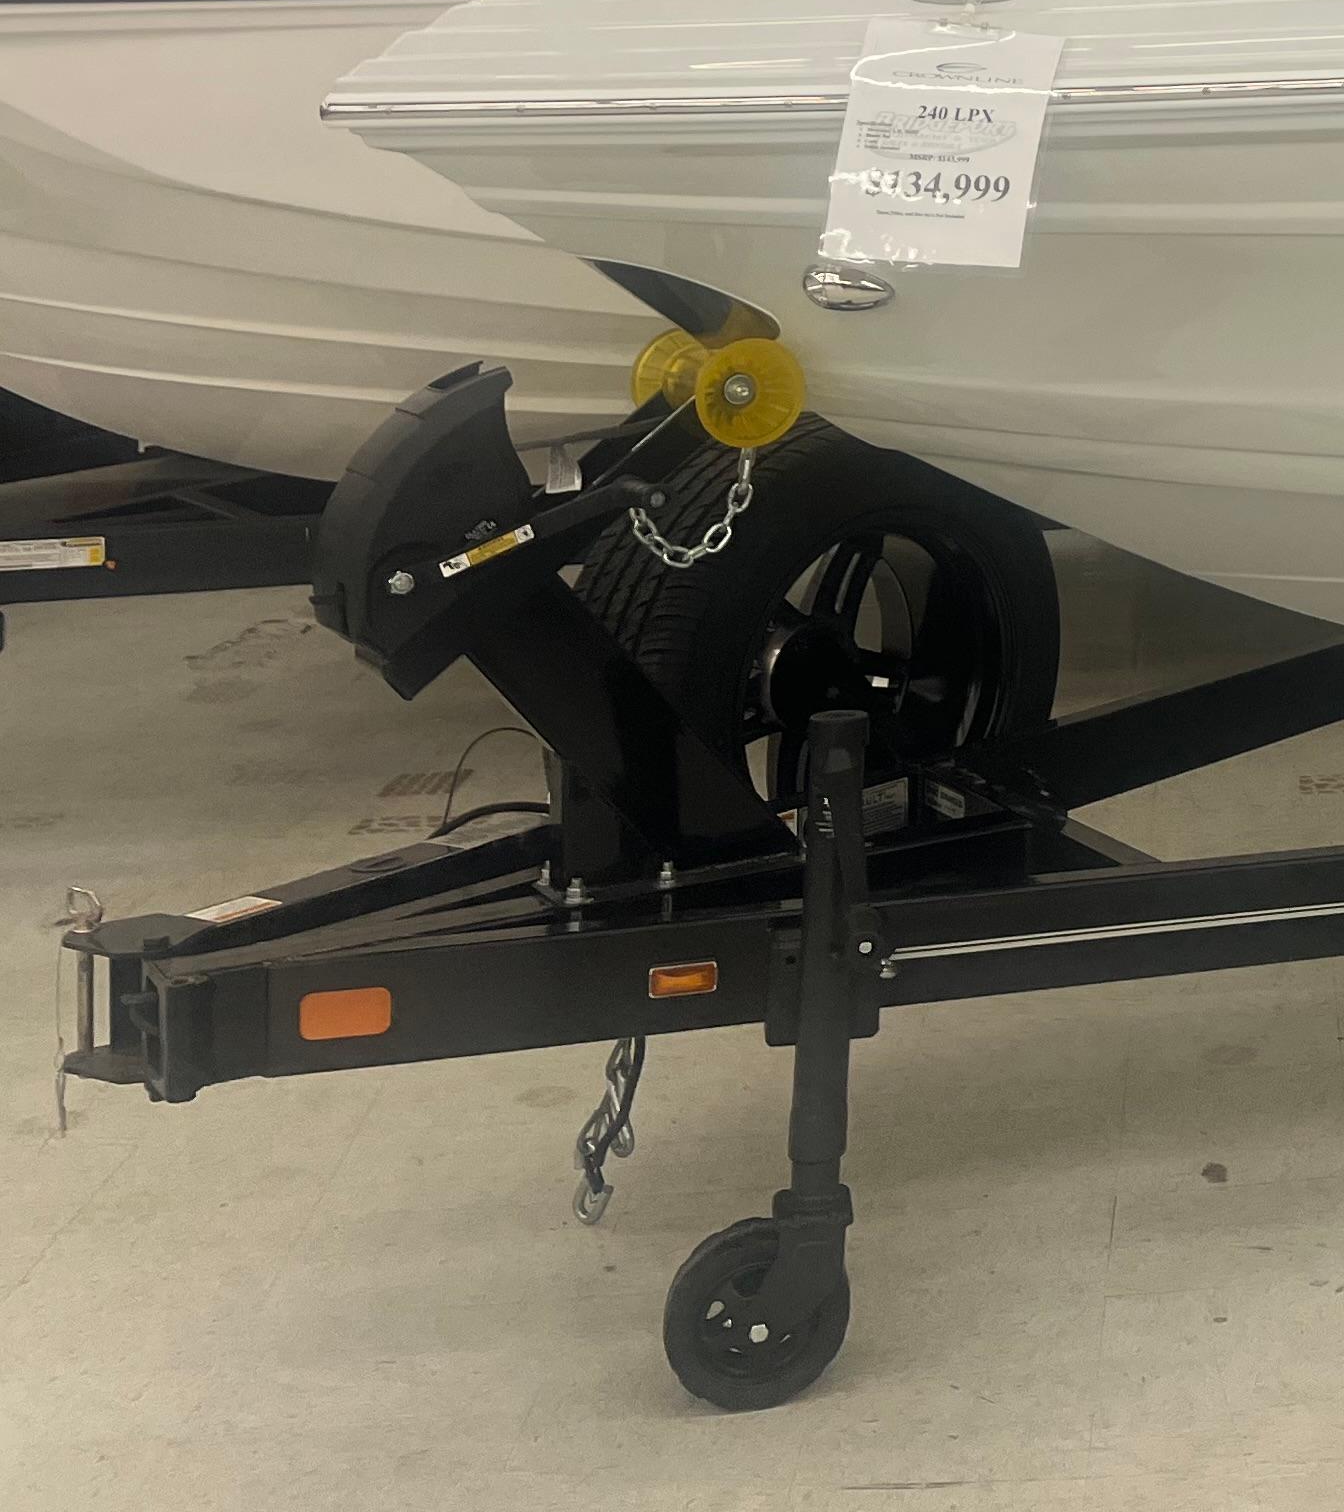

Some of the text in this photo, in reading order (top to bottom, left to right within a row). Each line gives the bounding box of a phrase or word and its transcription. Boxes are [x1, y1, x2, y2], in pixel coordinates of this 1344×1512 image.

[918, 105, 995, 123] 240 LPX
[865, 168, 1011, 205] $134,999
